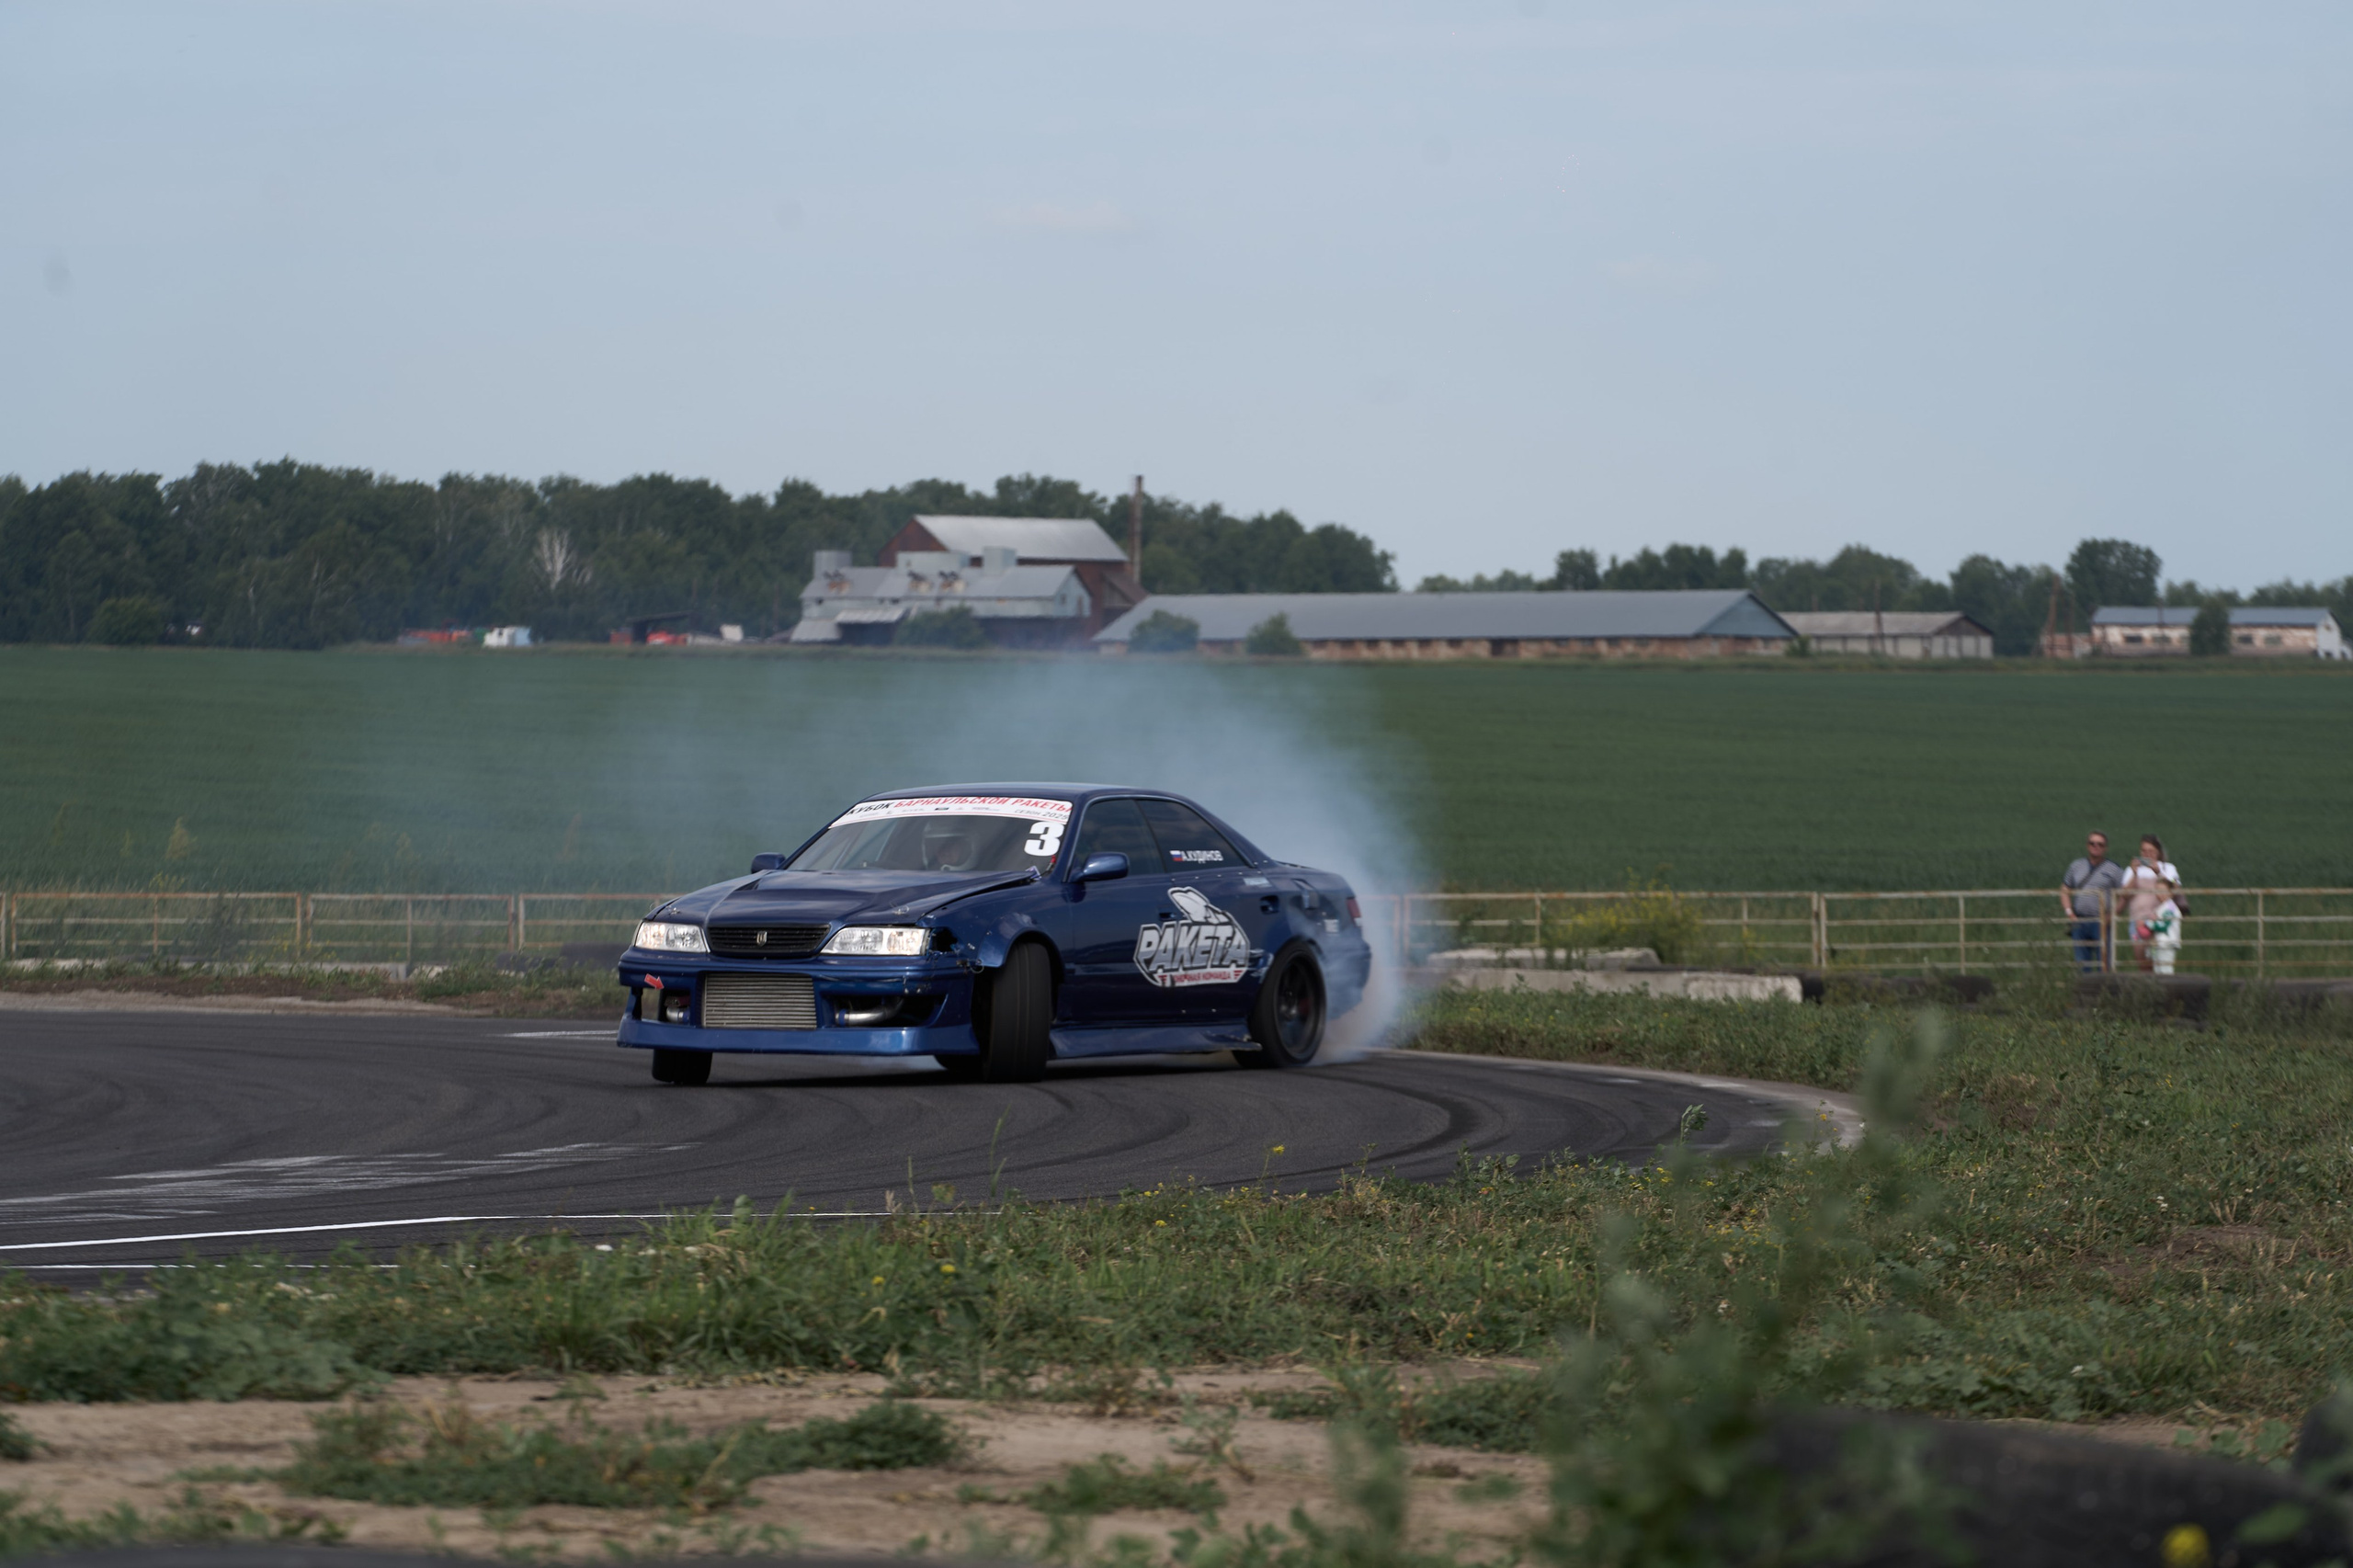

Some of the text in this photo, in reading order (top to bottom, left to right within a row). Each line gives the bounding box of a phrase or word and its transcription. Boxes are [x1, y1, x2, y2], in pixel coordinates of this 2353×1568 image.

[847, 802, 893, 815] КУБОК
[894, 797, 1011, 808] БАРНАУЛЬСКОЙ
[1042, 812, 1068, 821] 2025
[1024, 821, 1064, 857] 3
[1137, 923, 1246, 972] РАКЕТА
